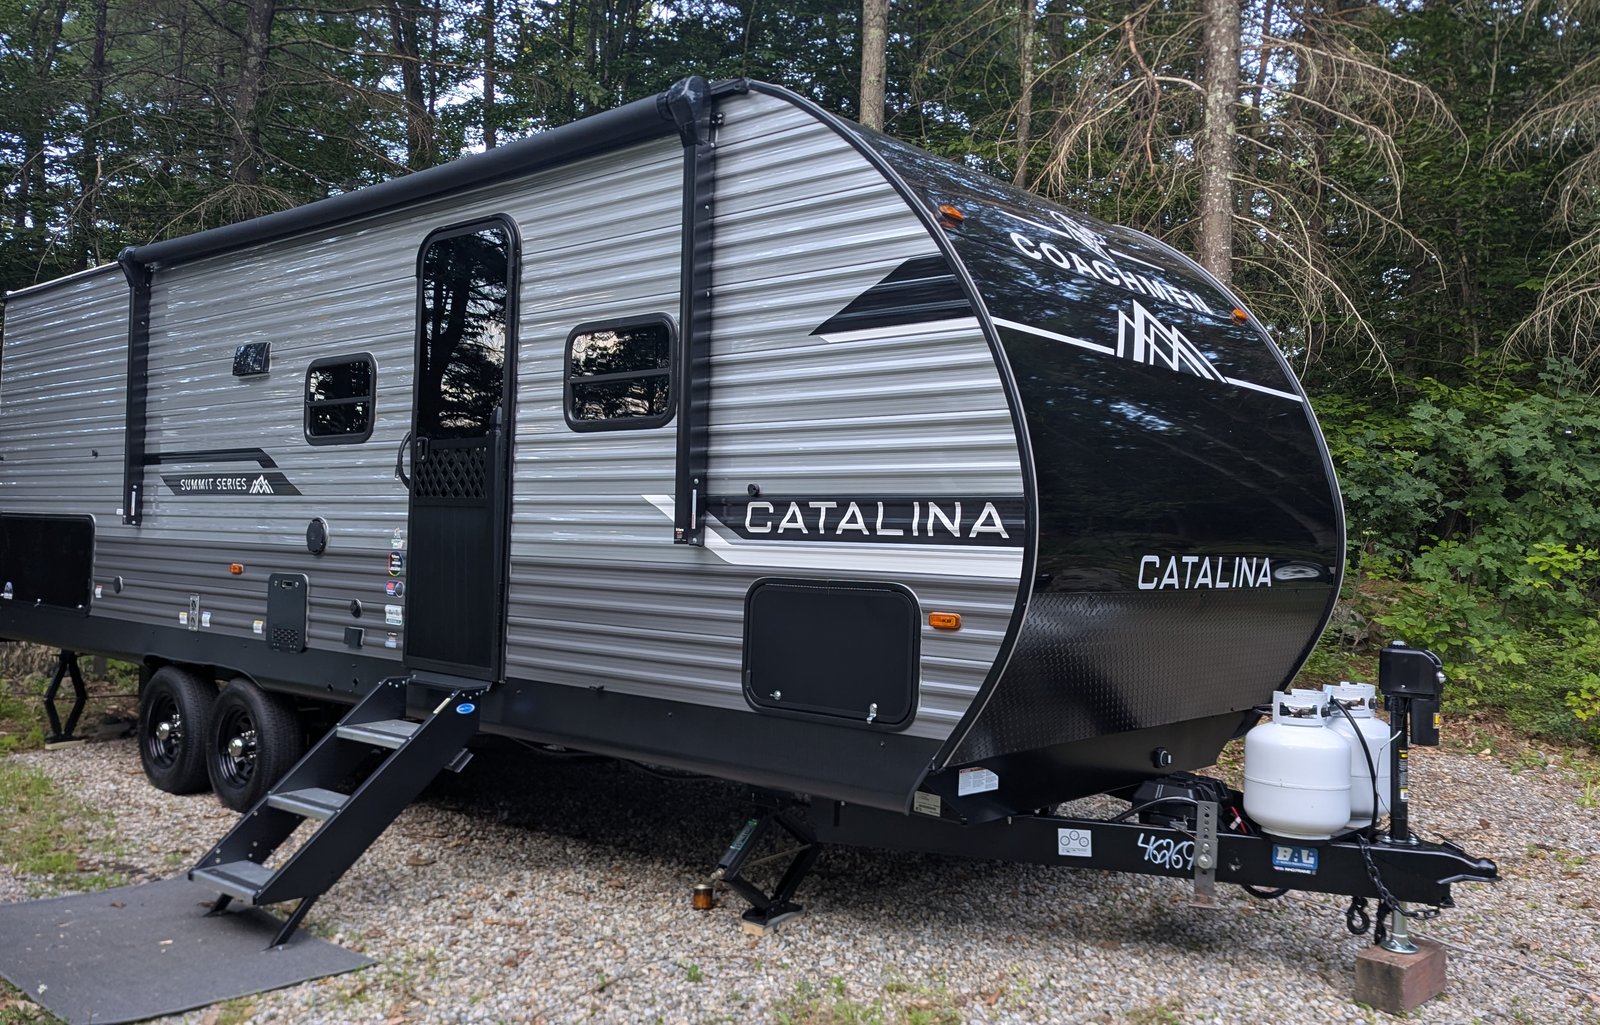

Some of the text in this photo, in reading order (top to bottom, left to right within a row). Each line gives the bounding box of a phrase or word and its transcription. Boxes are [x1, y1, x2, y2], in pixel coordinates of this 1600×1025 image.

[1010, 232, 1214, 315] COACHMEN
[180, 477, 247, 491] SUMMIT SERIES
[744, 501, 1010, 539] CATALINA
[1137, 555, 1272, 590] CATALINA
